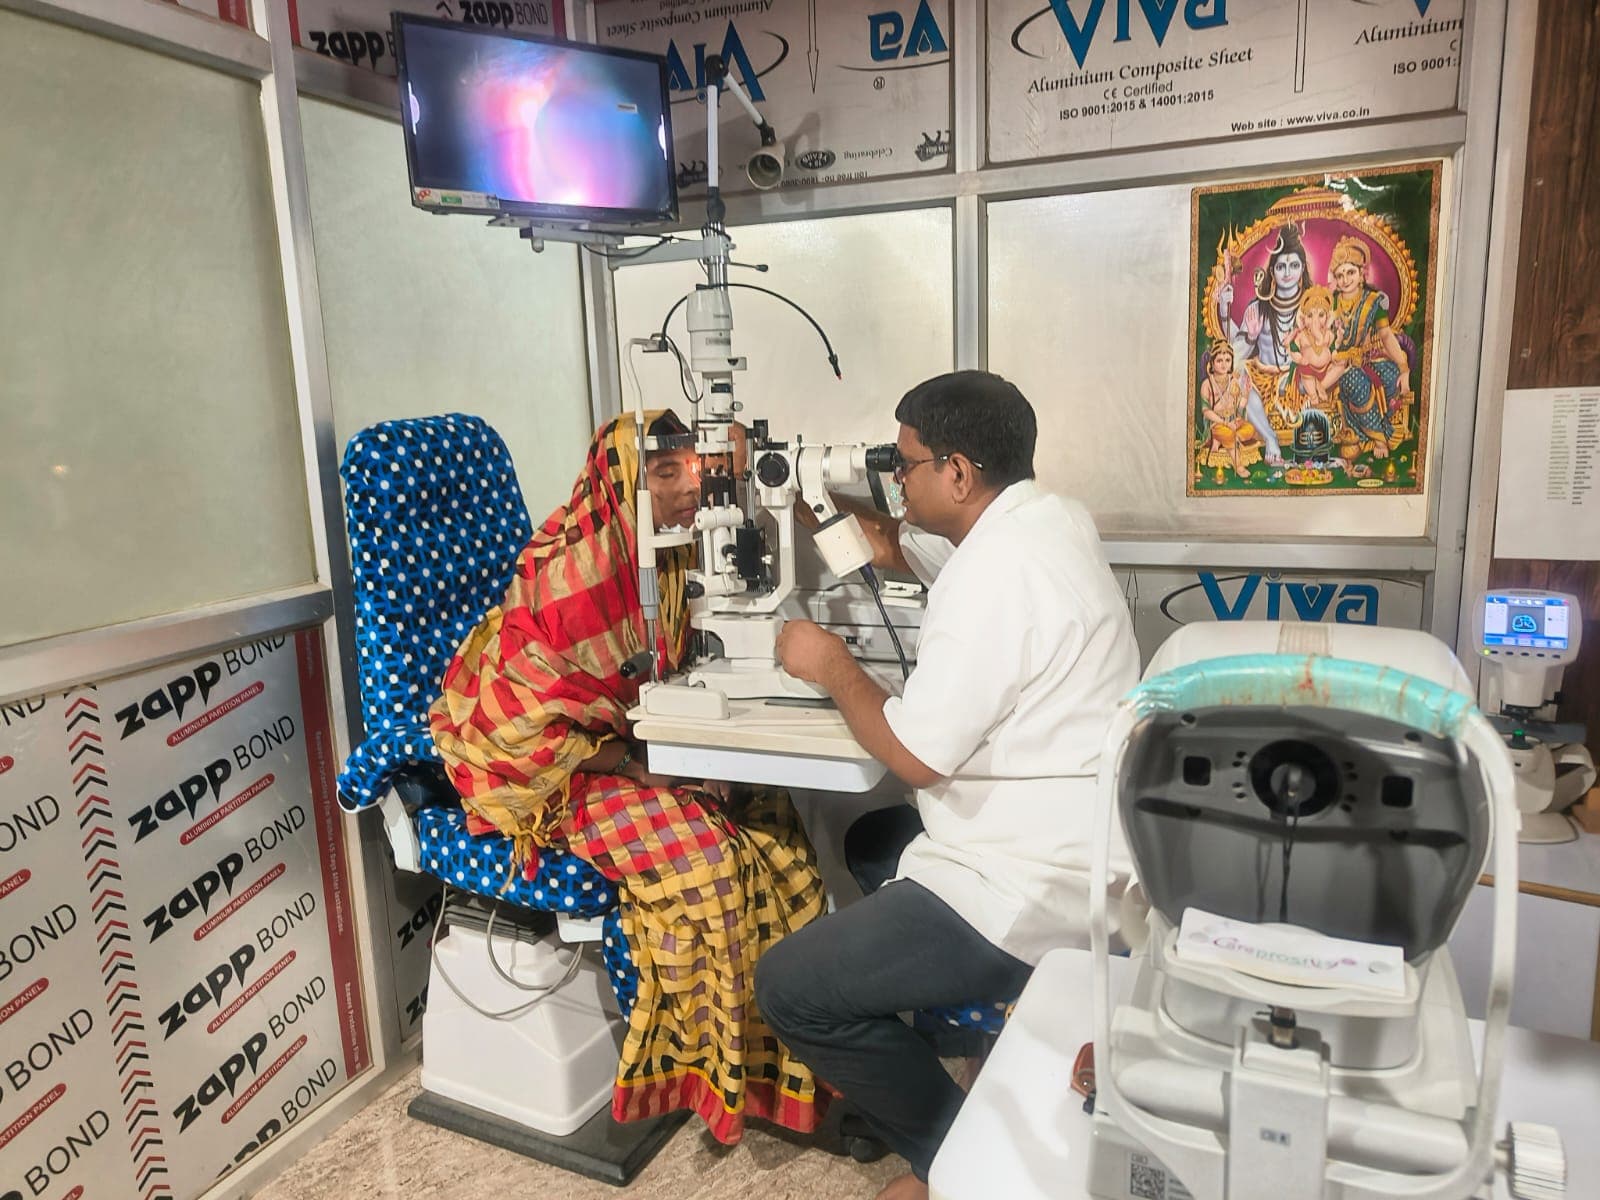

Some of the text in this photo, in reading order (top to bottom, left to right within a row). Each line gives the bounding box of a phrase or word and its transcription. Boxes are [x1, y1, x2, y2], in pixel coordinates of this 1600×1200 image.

[516, 3, 549, 25] BOND
[606, 21, 637, 37] Sheet
[640, 10, 701, 31] Composite
[1027, 47, 1254, 94] Aluminium Composite Sheet
[1123, 80, 1173, 98] Certified
[1393, 56, 1460, 75] ISO 9001:
[1059, 90, 1214, 120] ISO 9001:2015 & 14001:2015
[1231, 120, 1255, 133] Web
[1257, 117, 1277, 129] site
[1286, 106, 1370, 126] www.viva.co.in
[843, 147, 893, 160] Celebrating
[1197, 571, 1379, 626] Viva
[114, 661, 221, 740] zapp
[172, 685, 261, 743] ALUMINIUM PARTITION PANEL
[128, 716, 295, 844] zapp BOND
[185, 777, 272, 841] ALUMINIUM PARTITION PANEL
[143, 805, 305, 944] zapp BOND
[199, 867, 282, 937] ALUMINIUM PARTITION PANEL
[158, 892, 316, 1041] zapp BOND
[212, 954, 293, 1030] ALUMINIUM PARTITION PANEL
[15, 984, 43, 1009] PANEL
[5, 1008, 94, 1092] BOND
[172, 1032, 268, 1135] zapp
[268, 975, 326, 1040] BOND
[225, 1085, 259, 1120] ALUMINIUM
[257, 1055, 287, 1090] PARTITION
[285, 1038, 304, 1060] PANEL
[30, 1089, 61, 1116] PANEL
[281, 1058, 337, 1124] BOND
[24, 1110, 110, 1197] BOND
